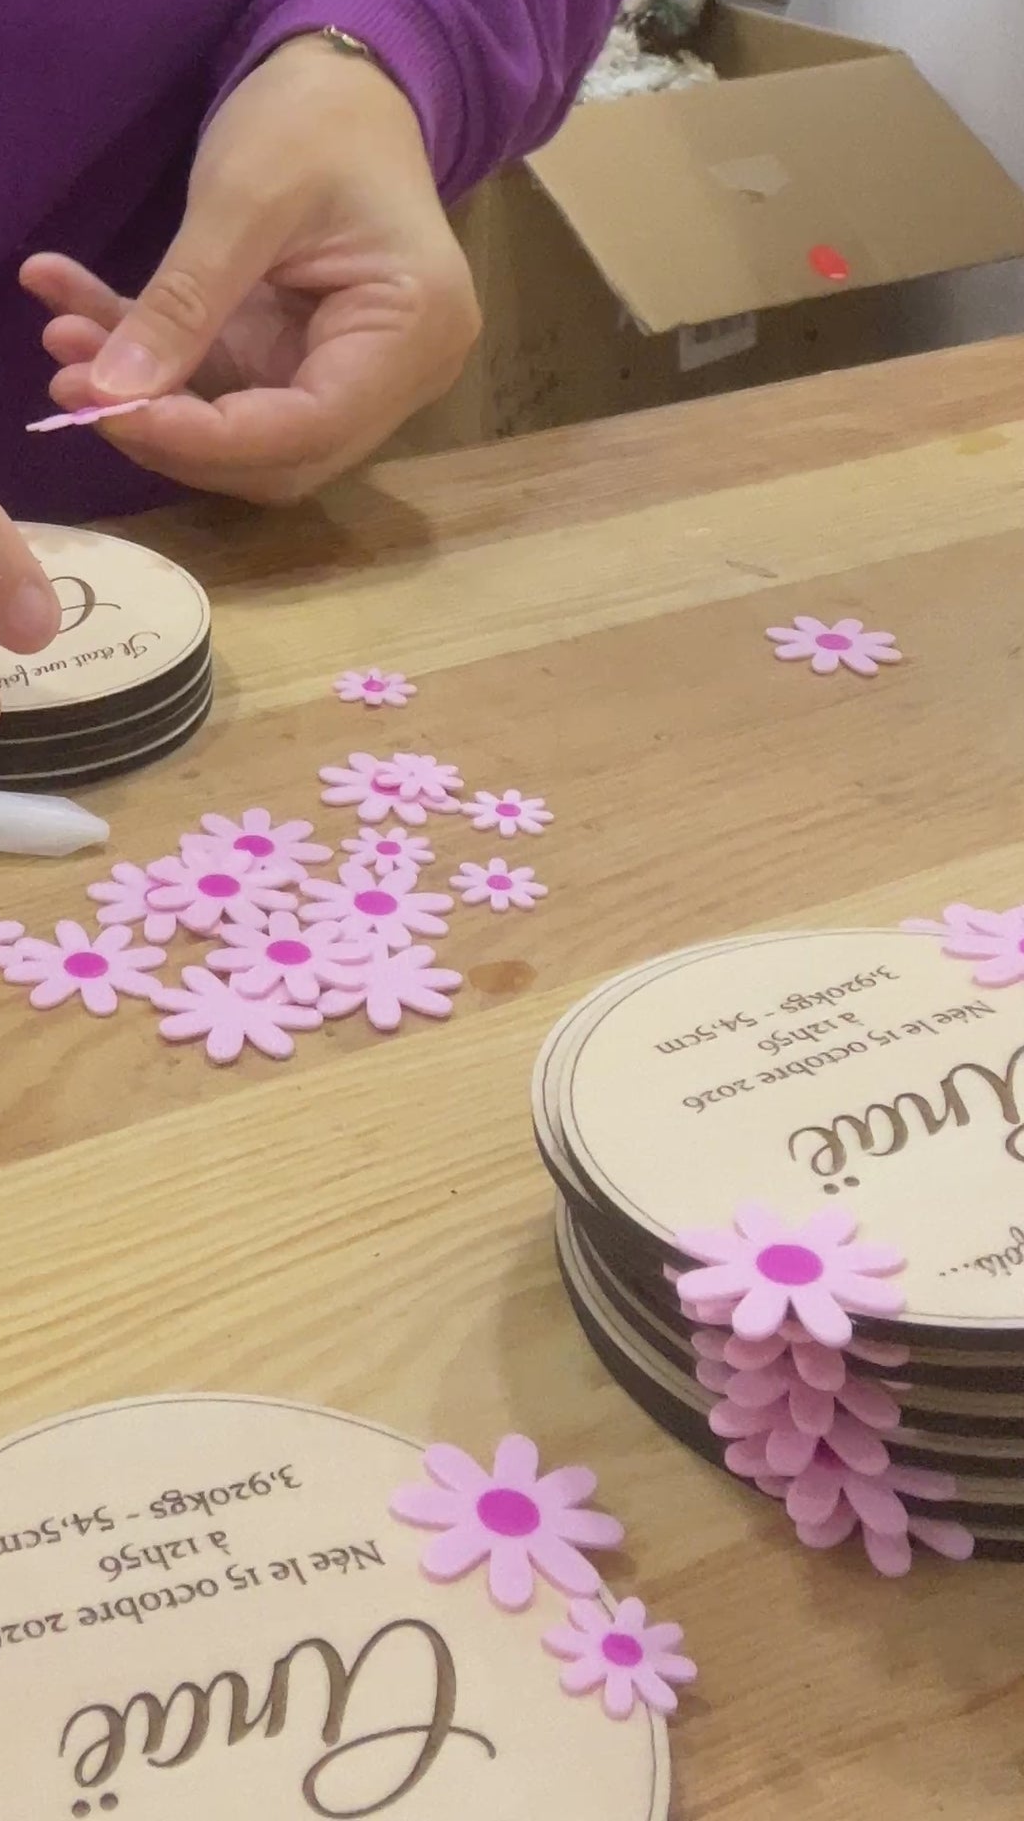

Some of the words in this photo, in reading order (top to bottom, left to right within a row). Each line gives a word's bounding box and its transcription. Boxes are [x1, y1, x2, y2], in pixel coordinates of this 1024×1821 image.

[31, 660, 67, 676] une
[75, 646, 115, 667] était
[780, 965, 900, 1014] 3,920kgs
[840, 1011, 864, 1028] à
[902, 1019, 938, 1037] le
[932, 999, 997, 1024] Née
[654, 1010, 758, 1055] 54,5cm
[757, 1019, 838, 1056] 12h56
[868, 1027, 903, 1047] 15
[757, 1040, 869, 1084] octobre
[682, 1079, 756, 1114] 2026
[149, 1464, 304, 1520] 3,920kgs
[98, 1536, 200, 1582] 12h56
[207, 1530, 231, 1556] à
[309, 1539, 387, 1575] Née
[225, 1565, 263, 1591] 15
[268, 1557, 308, 1588] le
[77, 1577, 218, 1626] octobre
[58, 1618, 496, 1820] Anaë
